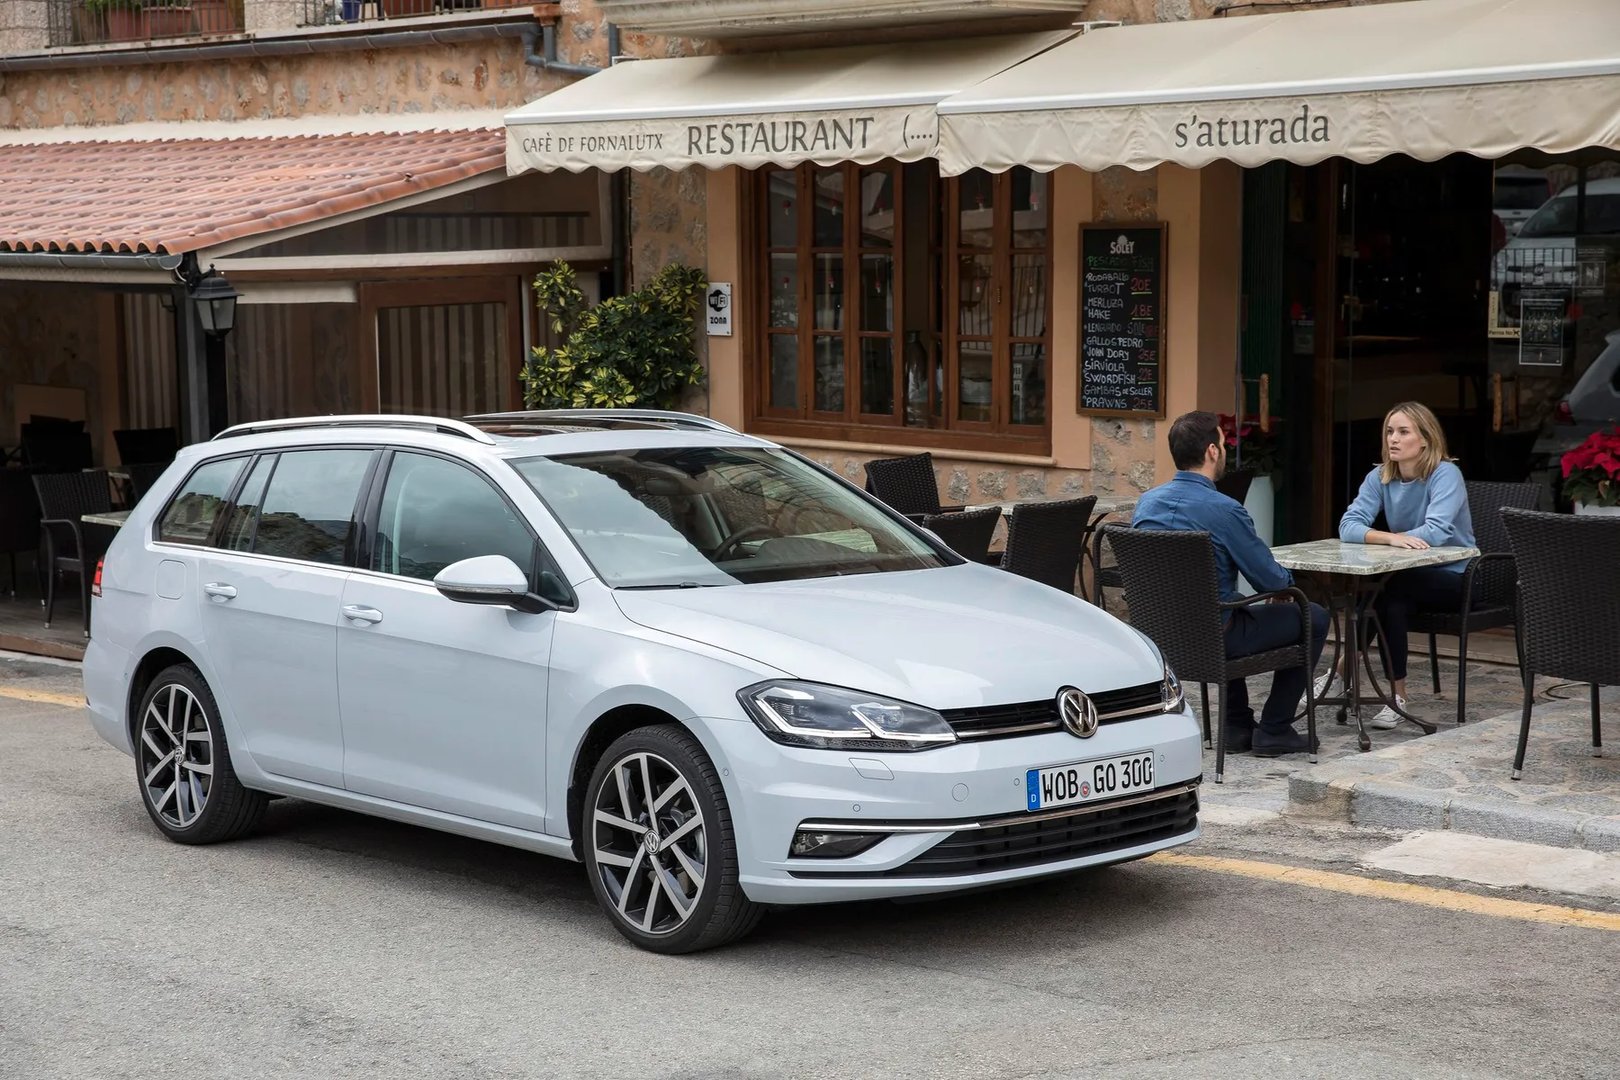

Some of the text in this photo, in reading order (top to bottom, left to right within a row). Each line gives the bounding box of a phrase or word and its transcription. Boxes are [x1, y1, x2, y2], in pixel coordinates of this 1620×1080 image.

[1175, 104, 1330, 148] s'aturada
[687, 116, 875, 155] RESTAURANT
[522, 132, 663, 153] CAFÈ DE FORNALUTX
[1109, 241, 1135, 254] SOLEY
[1087, 282, 1125, 295] TURBOT
[1087, 296, 1124, 309] MERLUZA
[1088, 308, 1111, 320] HAKE
[1117, 337, 1144, 348] PEDRO
[1087, 346, 1130, 361] JOHN DORY
[1083, 384, 1121, 396] GAMBAS
[1085, 397, 1128, 409] PRAWNS
[1041, 757, 1152, 803] WOB GO 300
[1031, 793, 1036, 803] D
